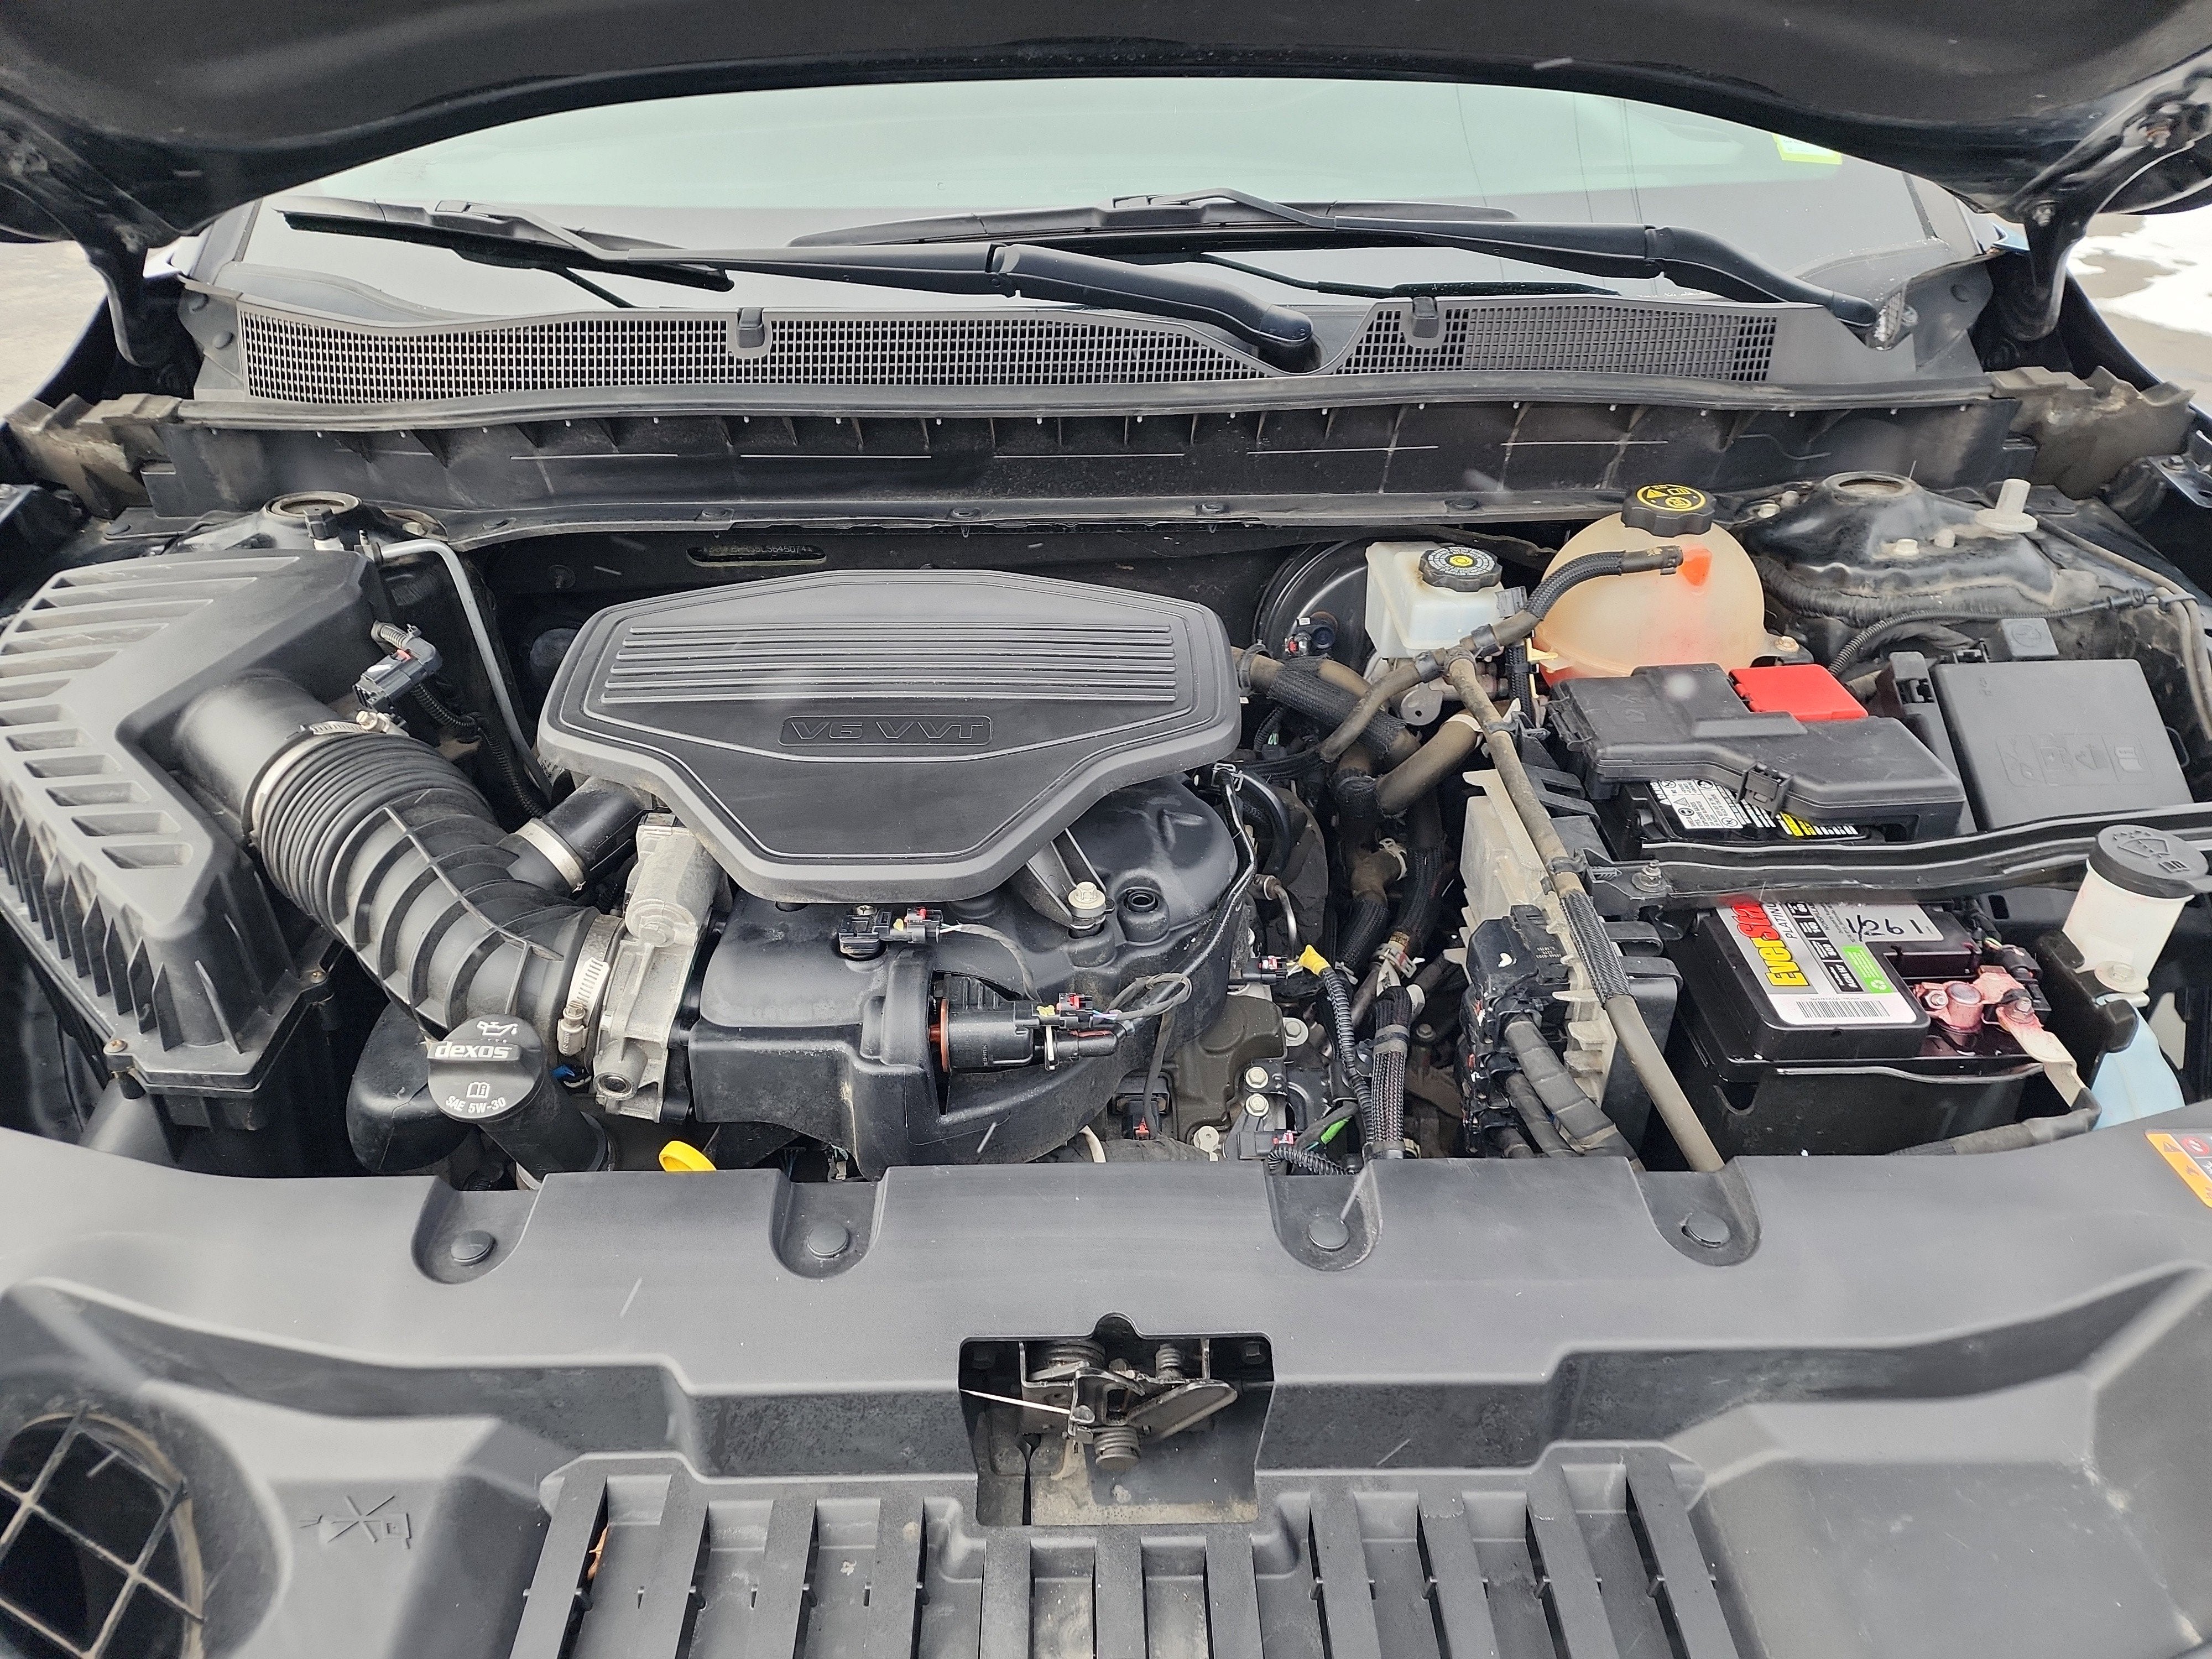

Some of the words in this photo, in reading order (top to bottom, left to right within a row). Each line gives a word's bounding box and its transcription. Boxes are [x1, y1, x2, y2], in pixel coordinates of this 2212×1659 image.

[791, 721, 863, 739] V6
[875, 721, 984, 739] VVT
[1650, 781, 1667, 800] DANG
[1766, 902, 1798, 940] PLATINU
[1808, 921, 1821, 933] 140
[1731, 903, 1811, 987] EverSta
[1822, 943, 1838, 957] 800
[445, 1095, 466, 1112] SAE
[468, 1097, 506, 1114] 5W-30
